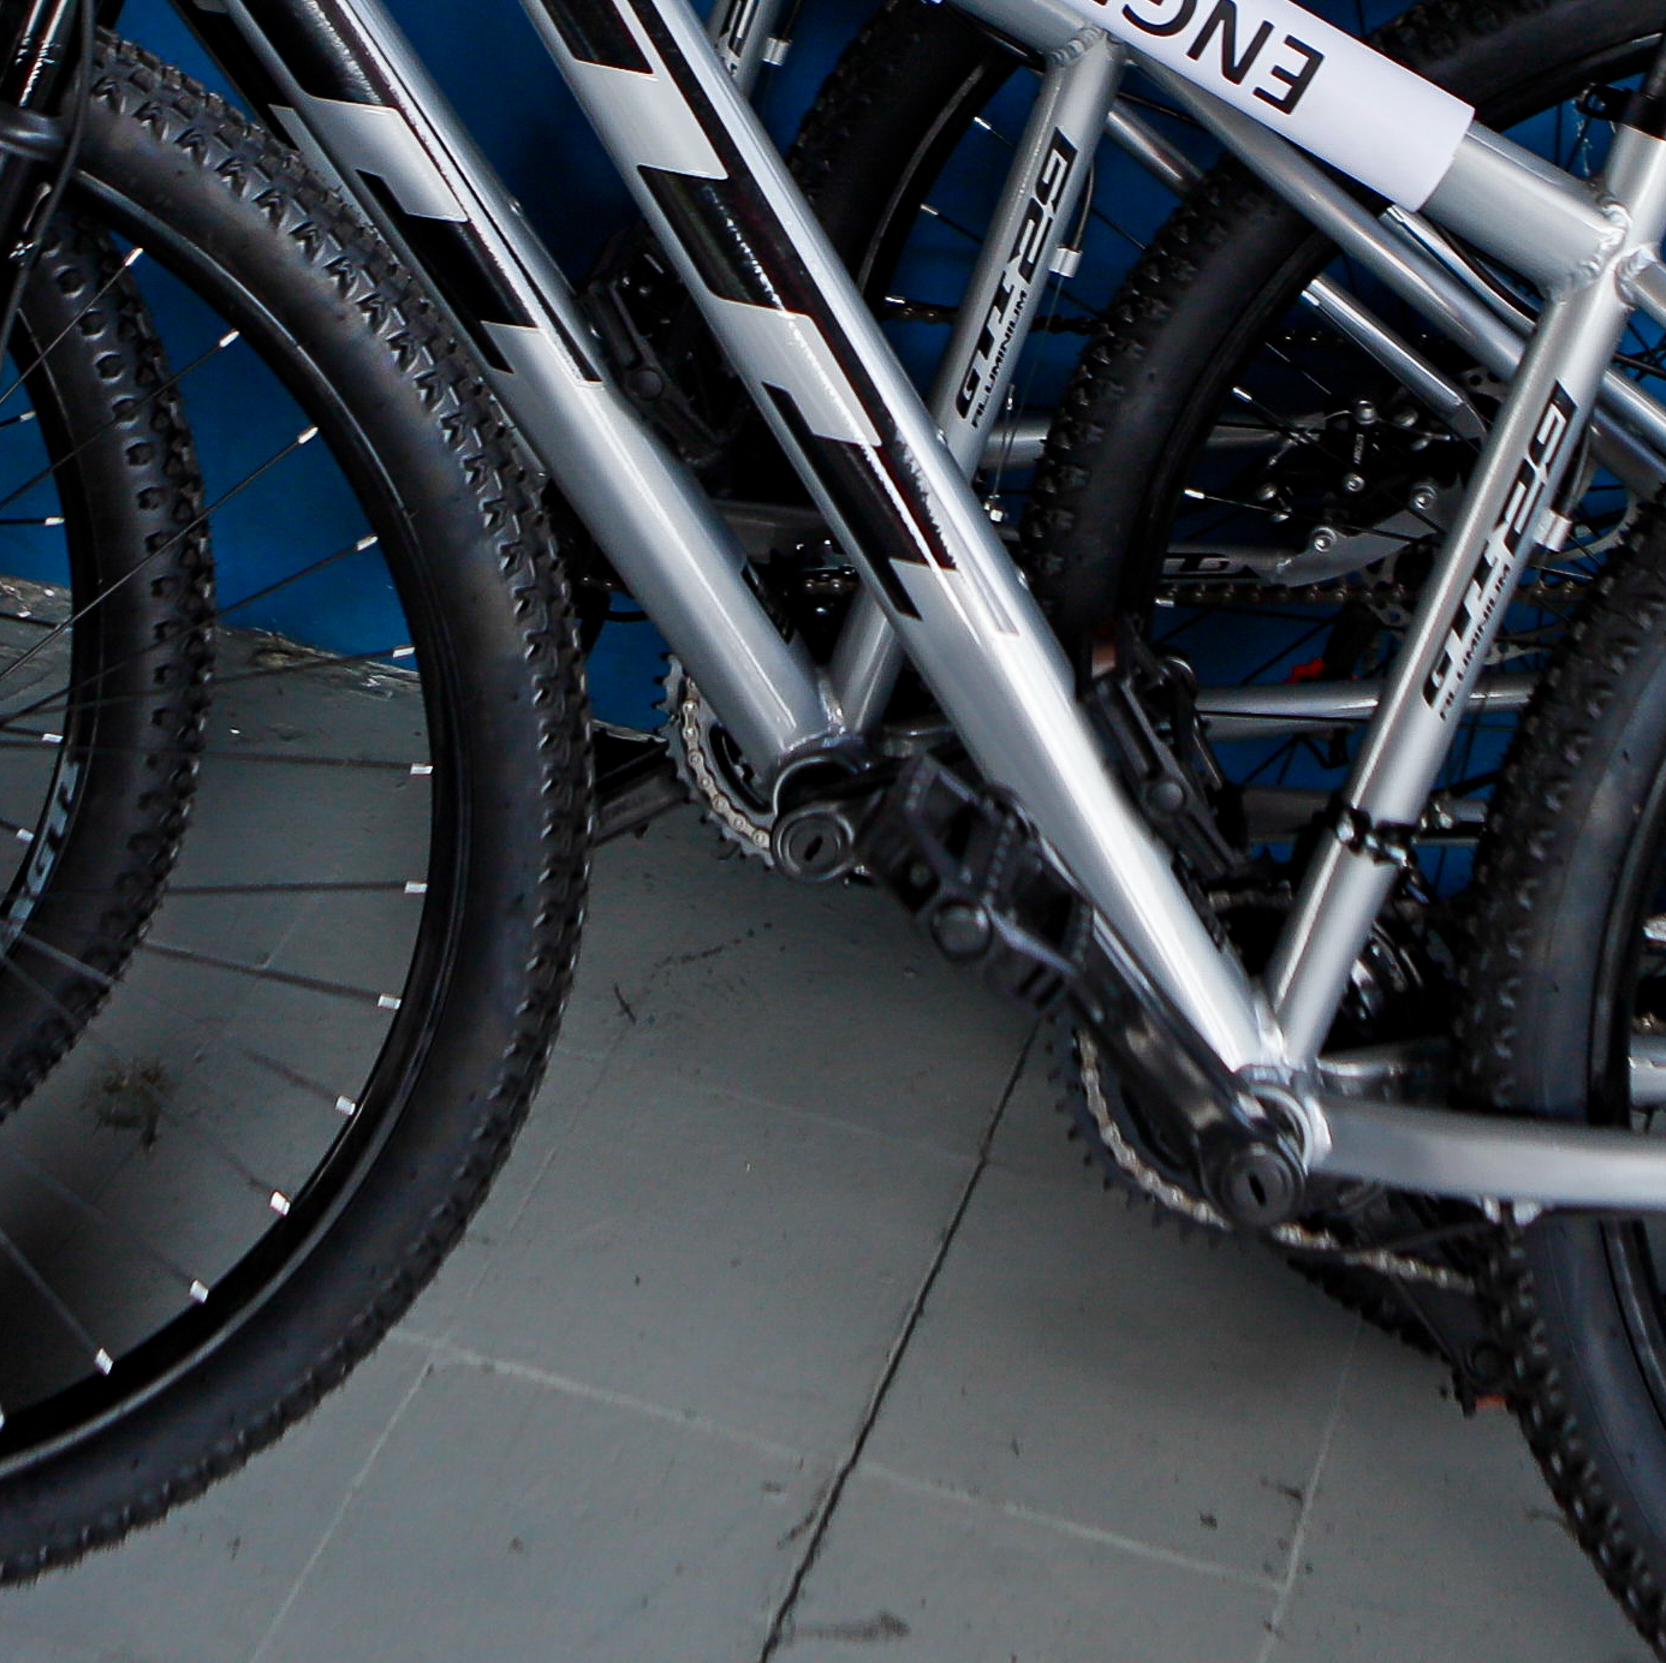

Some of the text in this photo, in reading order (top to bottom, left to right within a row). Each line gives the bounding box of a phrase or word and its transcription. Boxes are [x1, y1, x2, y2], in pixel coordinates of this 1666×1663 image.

[1010, 129, 1077, 281] 29
[969, 291, 1029, 429] ALUMINIUM
[1495, 381, 1577, 558] 29
